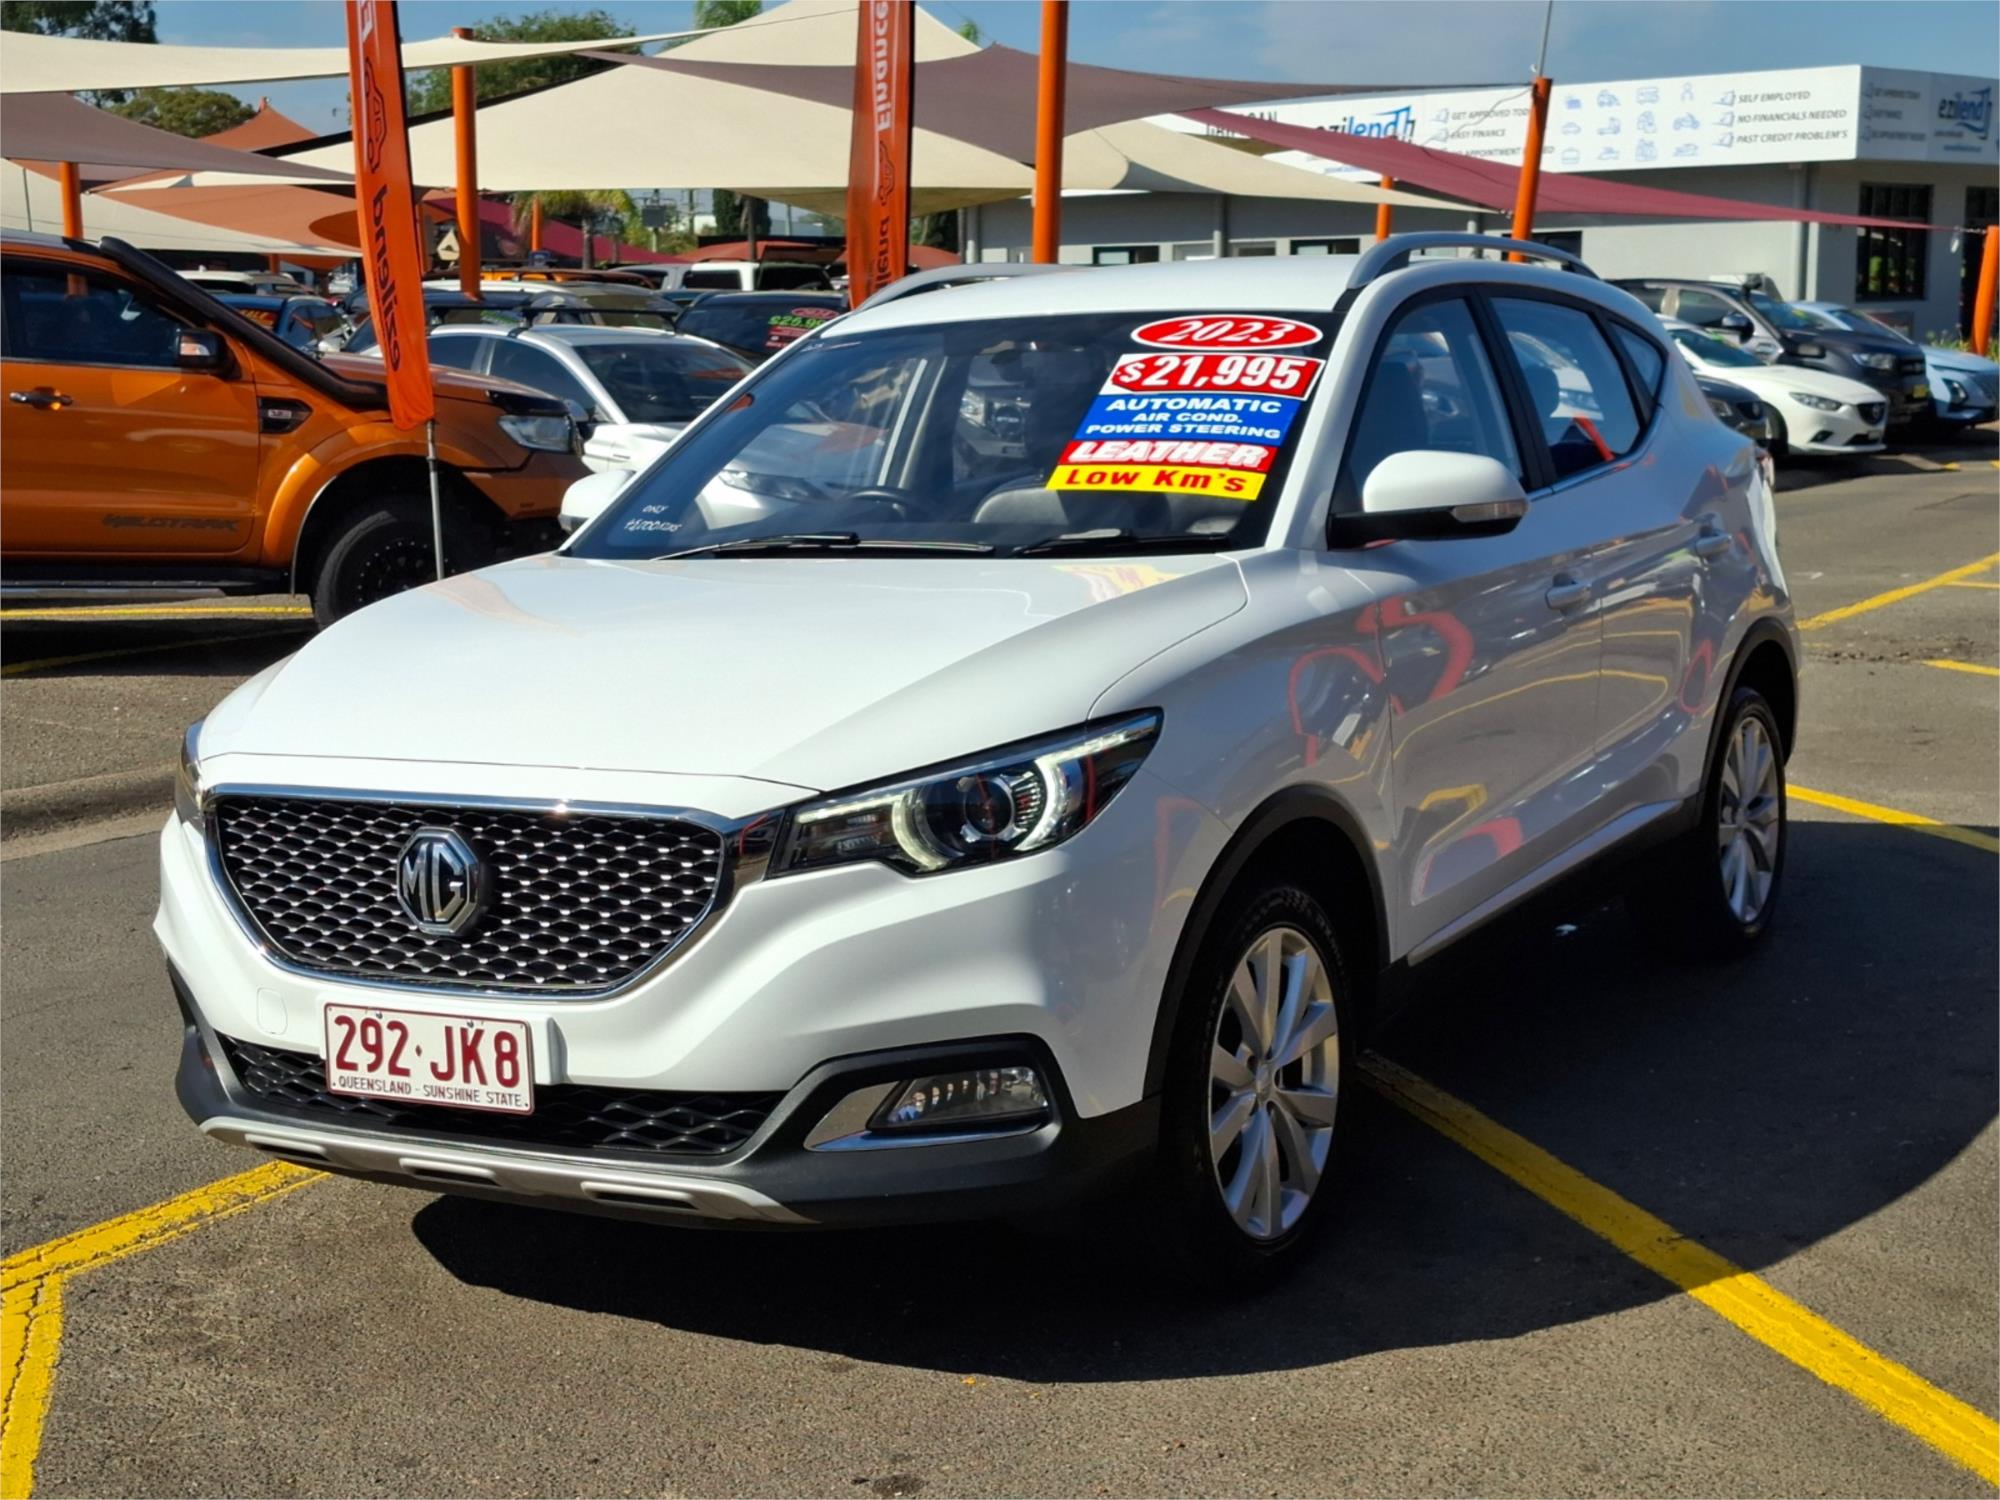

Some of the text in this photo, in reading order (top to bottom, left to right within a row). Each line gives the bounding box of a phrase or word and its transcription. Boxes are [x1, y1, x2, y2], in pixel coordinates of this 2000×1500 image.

[1738, 91, 1811, 104] SELF EMPLOYED
[1737, 109, 1848, 123] NO FINANCIALS NEEDED
[1737, 134, 1759, 144] PAST
[1760, 132, 1793, 143] CREDIT
[1156, 320, 1297, 343] 2023
[1119, 355, 1308, 390] $21,995
[1106, 397, 1282, 414] AUTOMATIC
[1133, 412, 1243, 424] AIR COND.
[1086, 424, 1281, 439] POWER STEERING
[1067, 441, 1270, 468] LEATHER
[402, 842, 464, 923] MG
[338, 1075, 522, 1107] QUEENSLAND SUNSHINE STATE
